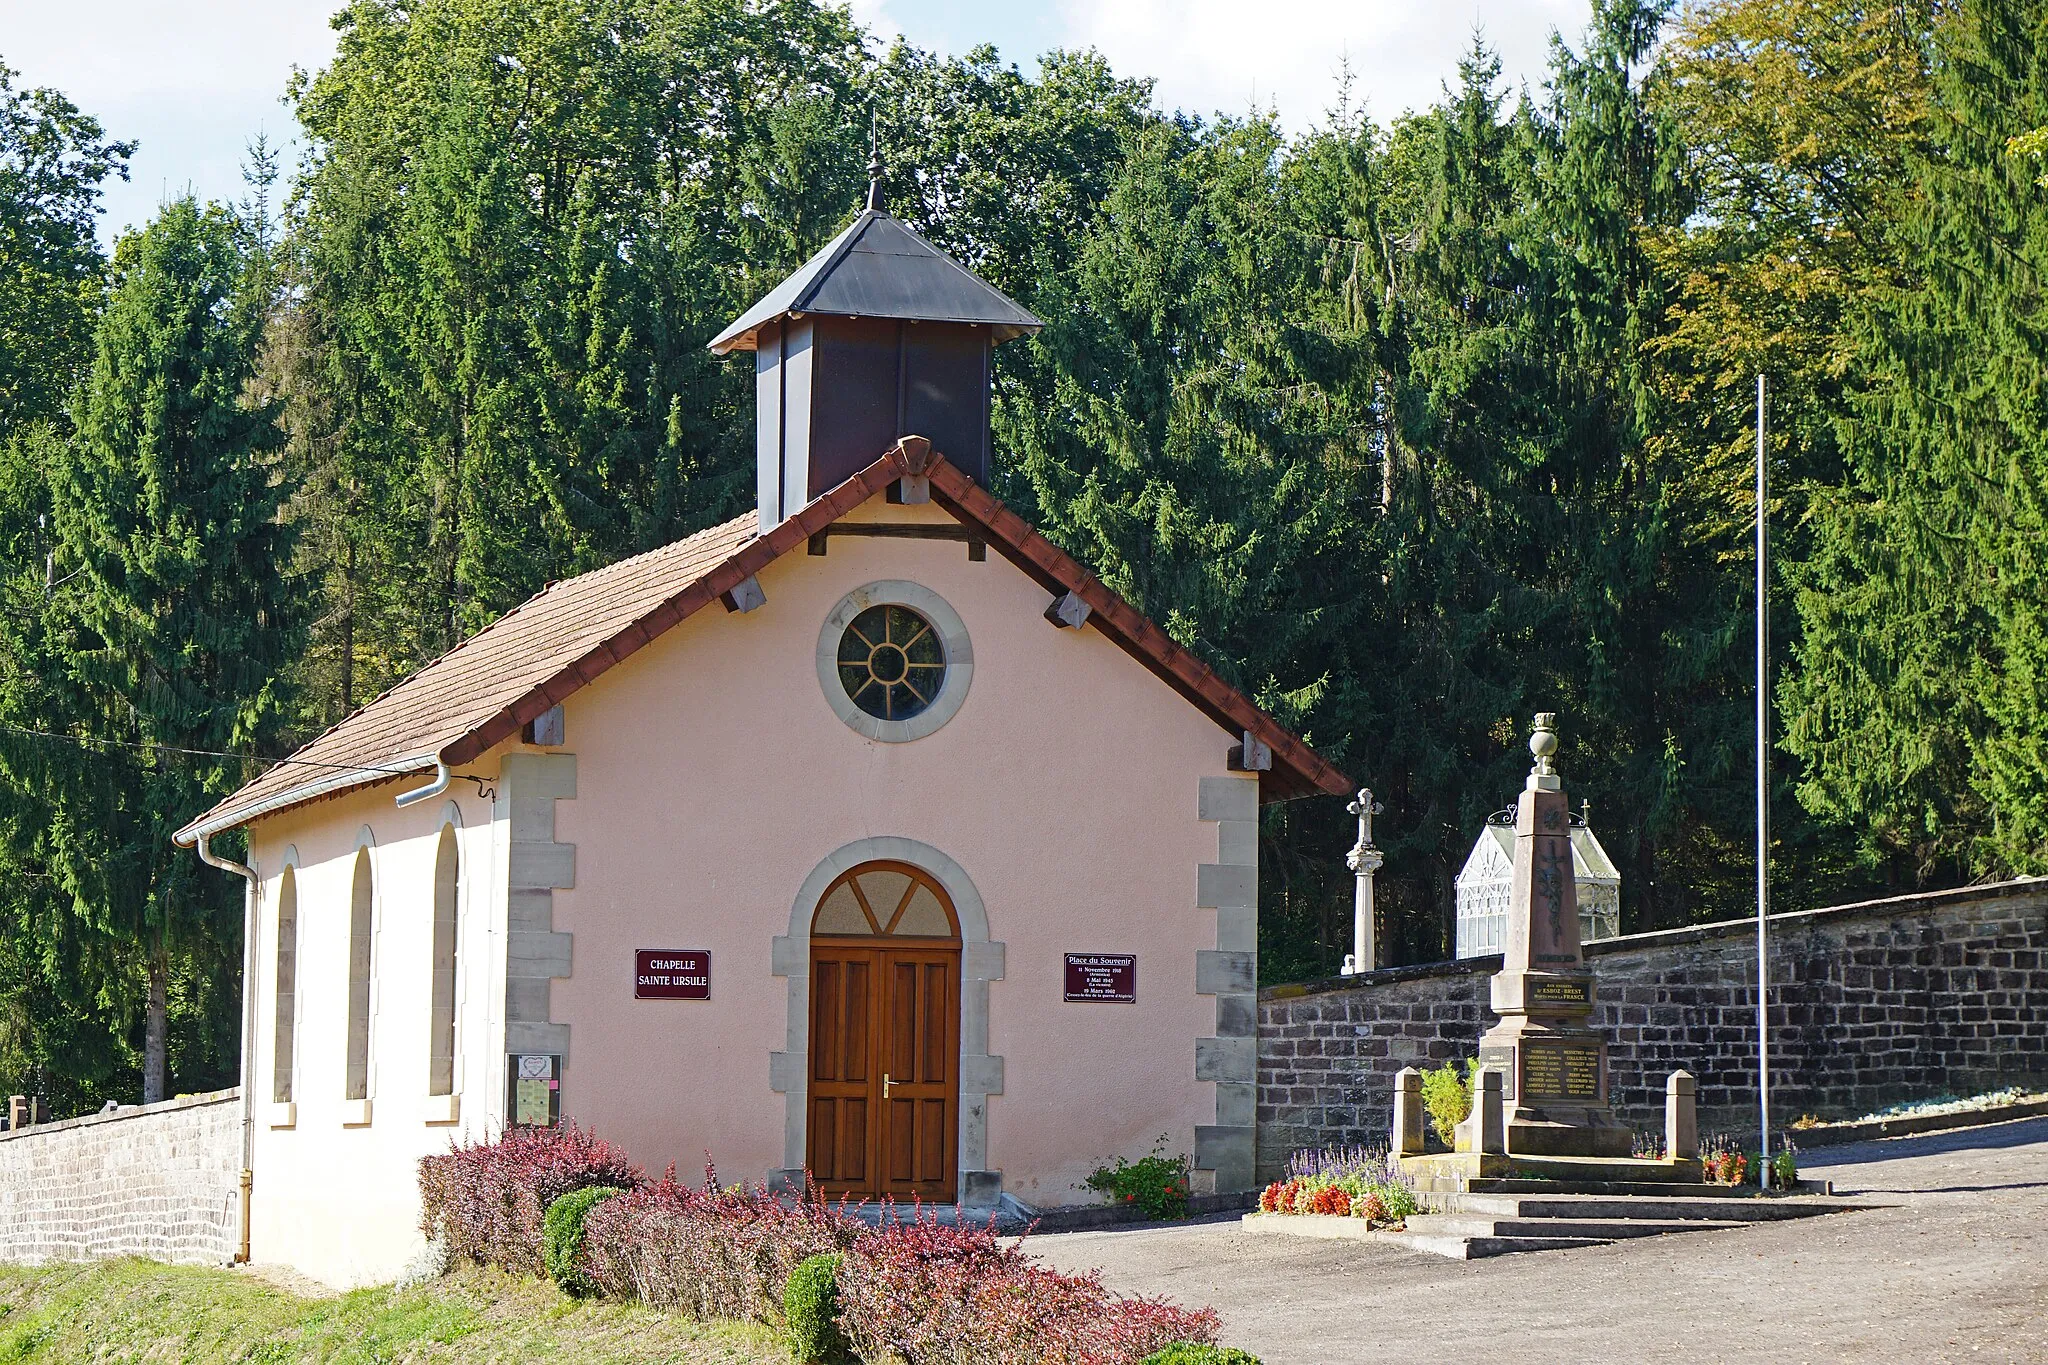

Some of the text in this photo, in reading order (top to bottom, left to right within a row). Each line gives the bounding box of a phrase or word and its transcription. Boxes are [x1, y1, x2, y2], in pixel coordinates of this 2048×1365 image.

[650, 960, 696, 970] CHAPELLE
[1069, 956, 1087, 964] Place
[1101, 957, 1131, 965] Souvenir
[638, 975, 707, 986] SAINTE URSULE
